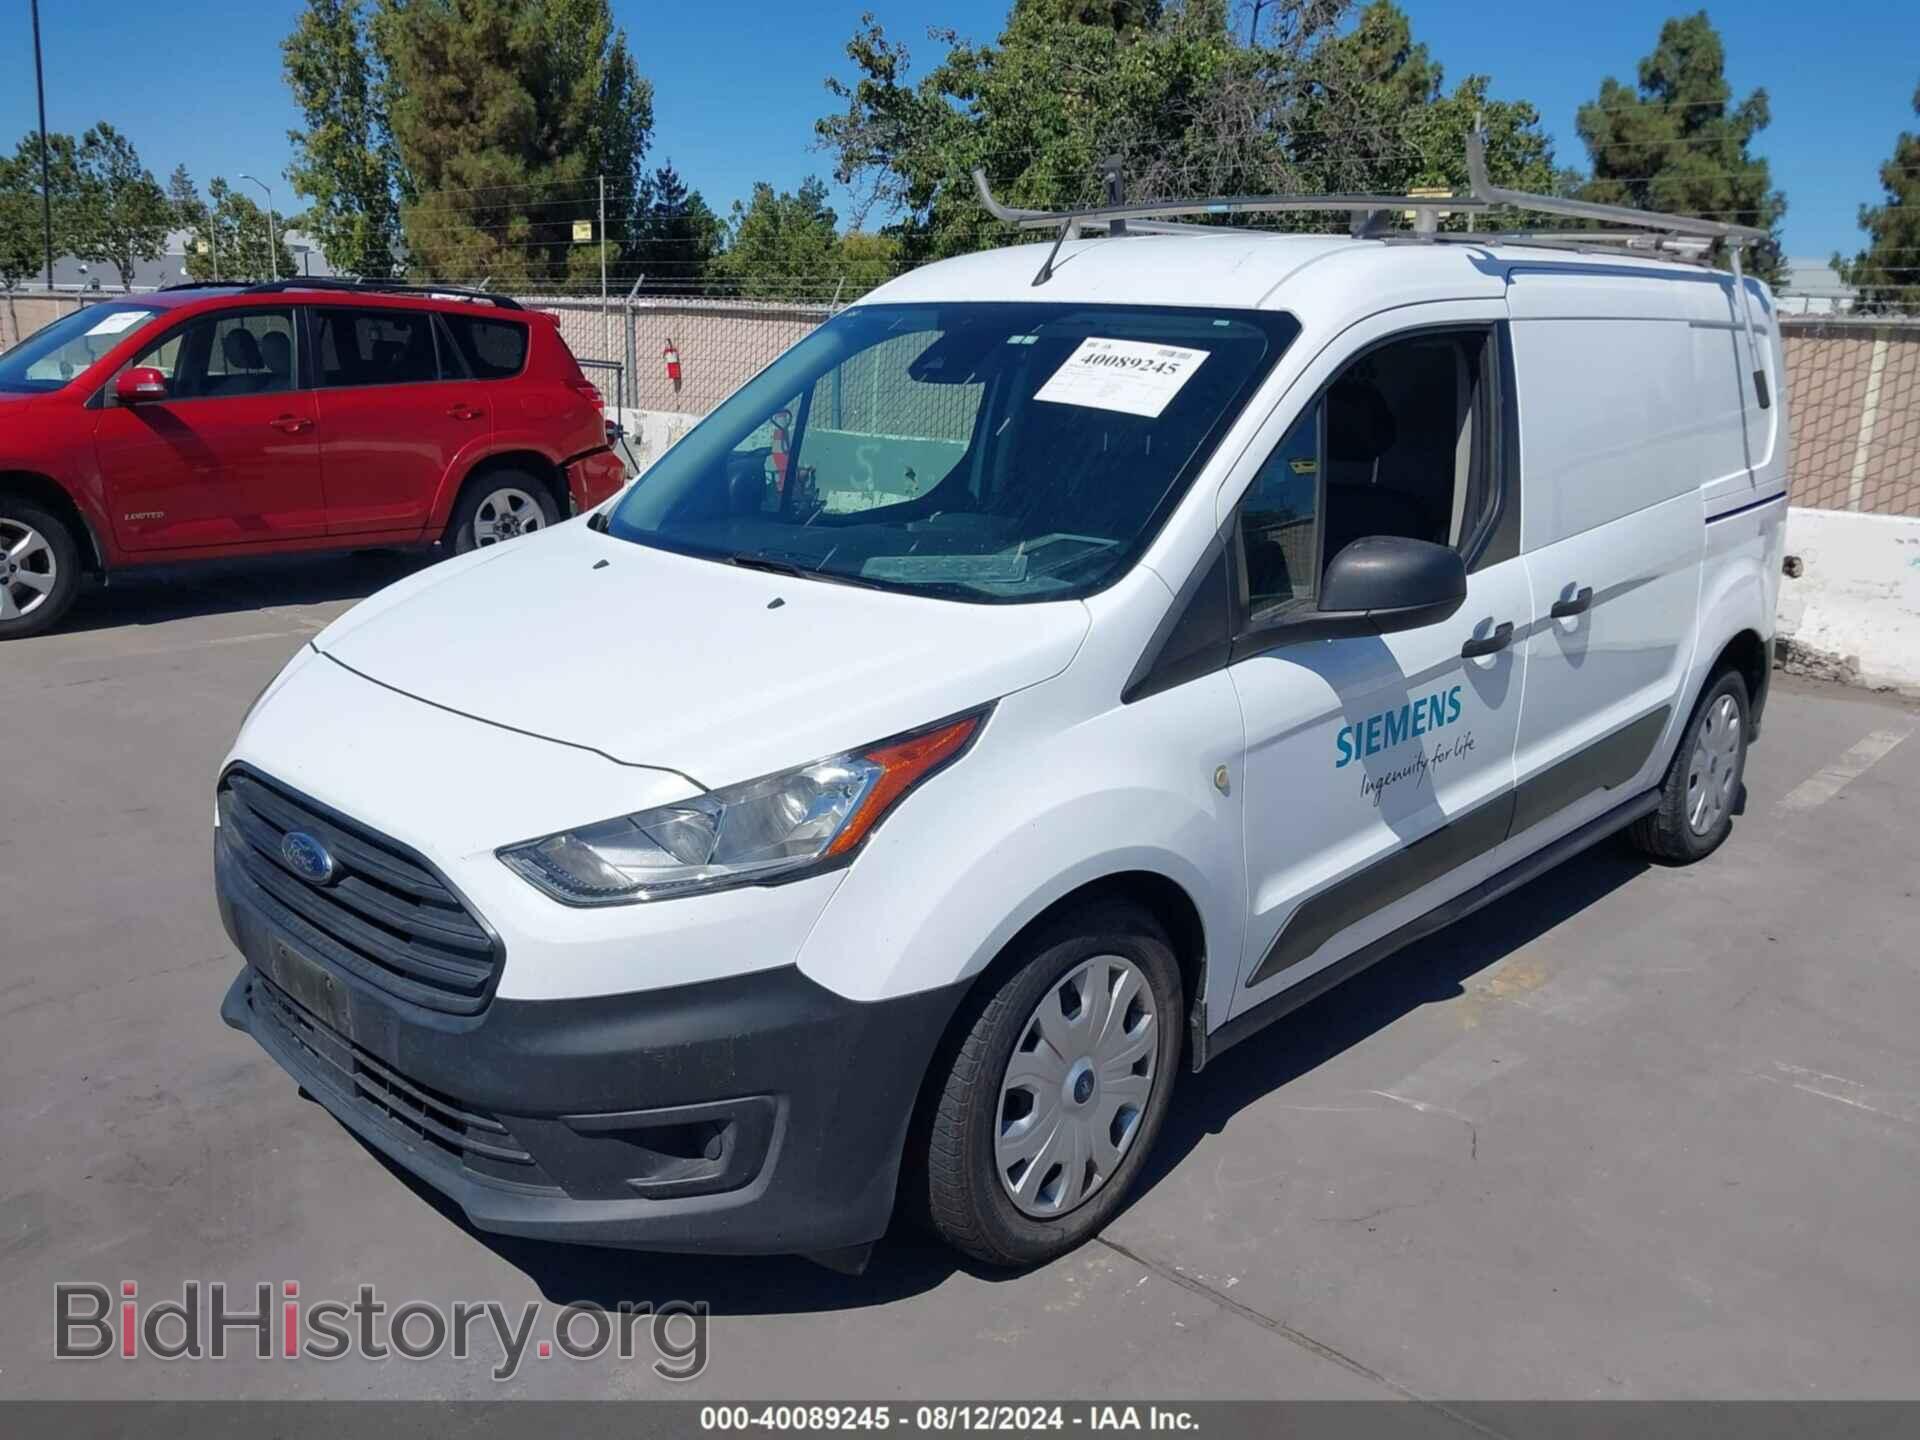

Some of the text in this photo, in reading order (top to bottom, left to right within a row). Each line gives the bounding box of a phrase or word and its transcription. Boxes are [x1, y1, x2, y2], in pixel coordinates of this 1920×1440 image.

[1080, 352, 1181, 376] 40089245
[1335, 685, 1462, 769] SIEMENS
[1360, 731, 1477, 807] Ingenuity for life
